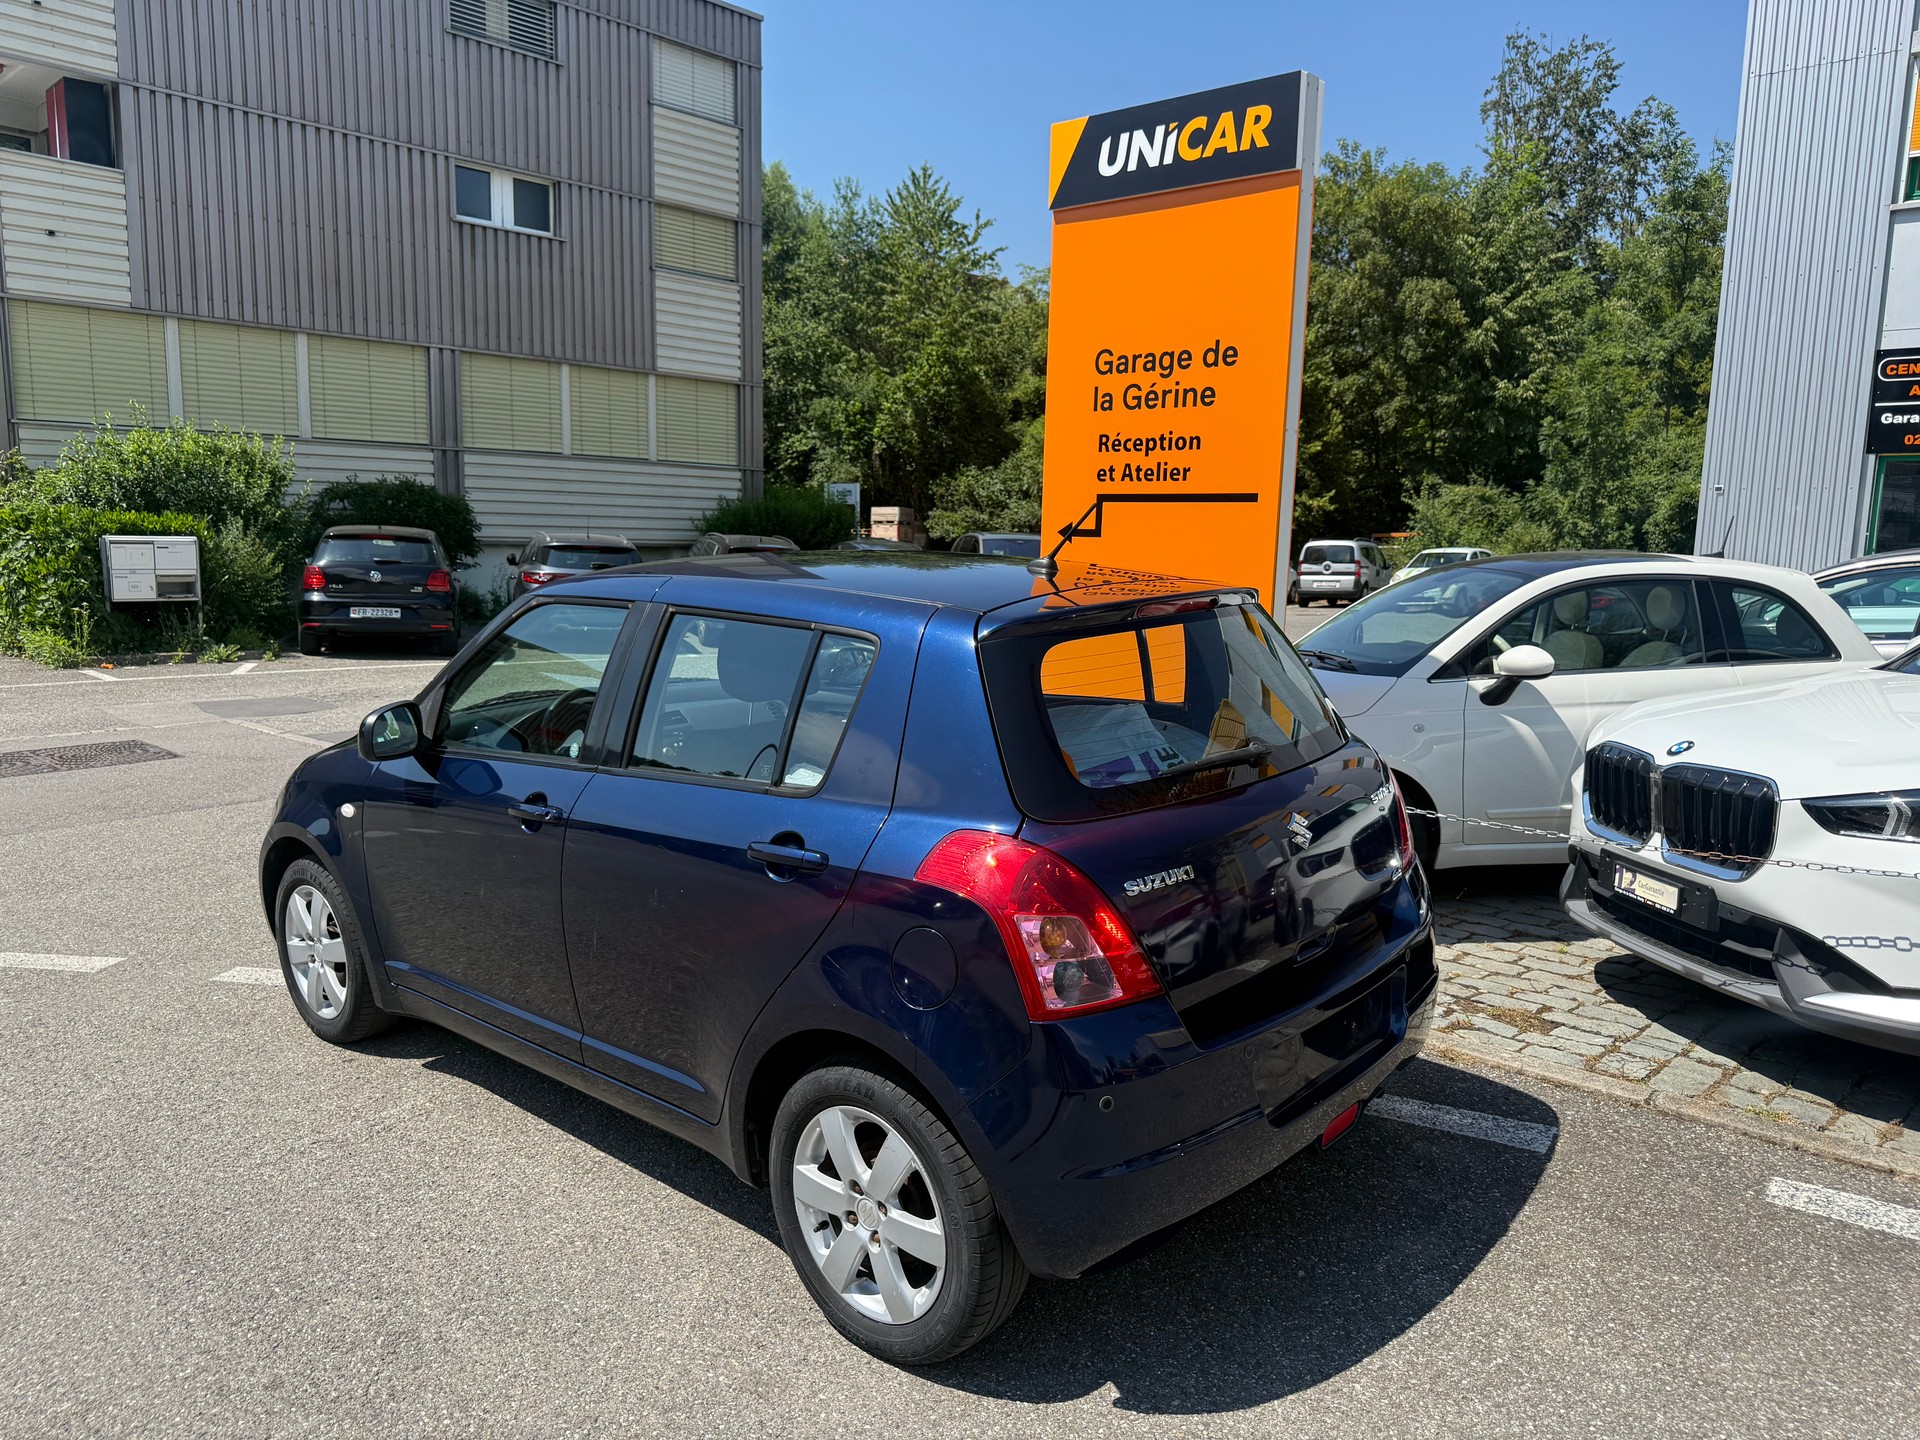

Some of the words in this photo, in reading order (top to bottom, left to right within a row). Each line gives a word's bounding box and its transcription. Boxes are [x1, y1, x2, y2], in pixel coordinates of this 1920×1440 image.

[1095, 349, 1193, 379] Garage
[1202, 340, 1239, 368] de
[1093, 386, 1114, 412] la
[1122, 381, 1217, 411] Gérine
[1098, 431, 1202, 457] Réception
[1096, 465, 1116, 482] et
[1120, 461, 1191, 482] Atelier
[370, 609, 394, 617] 22328
[1124, 864, 1195, 897] SUZUKI
[791, 1078, 876, 1113] GOODYEAR
